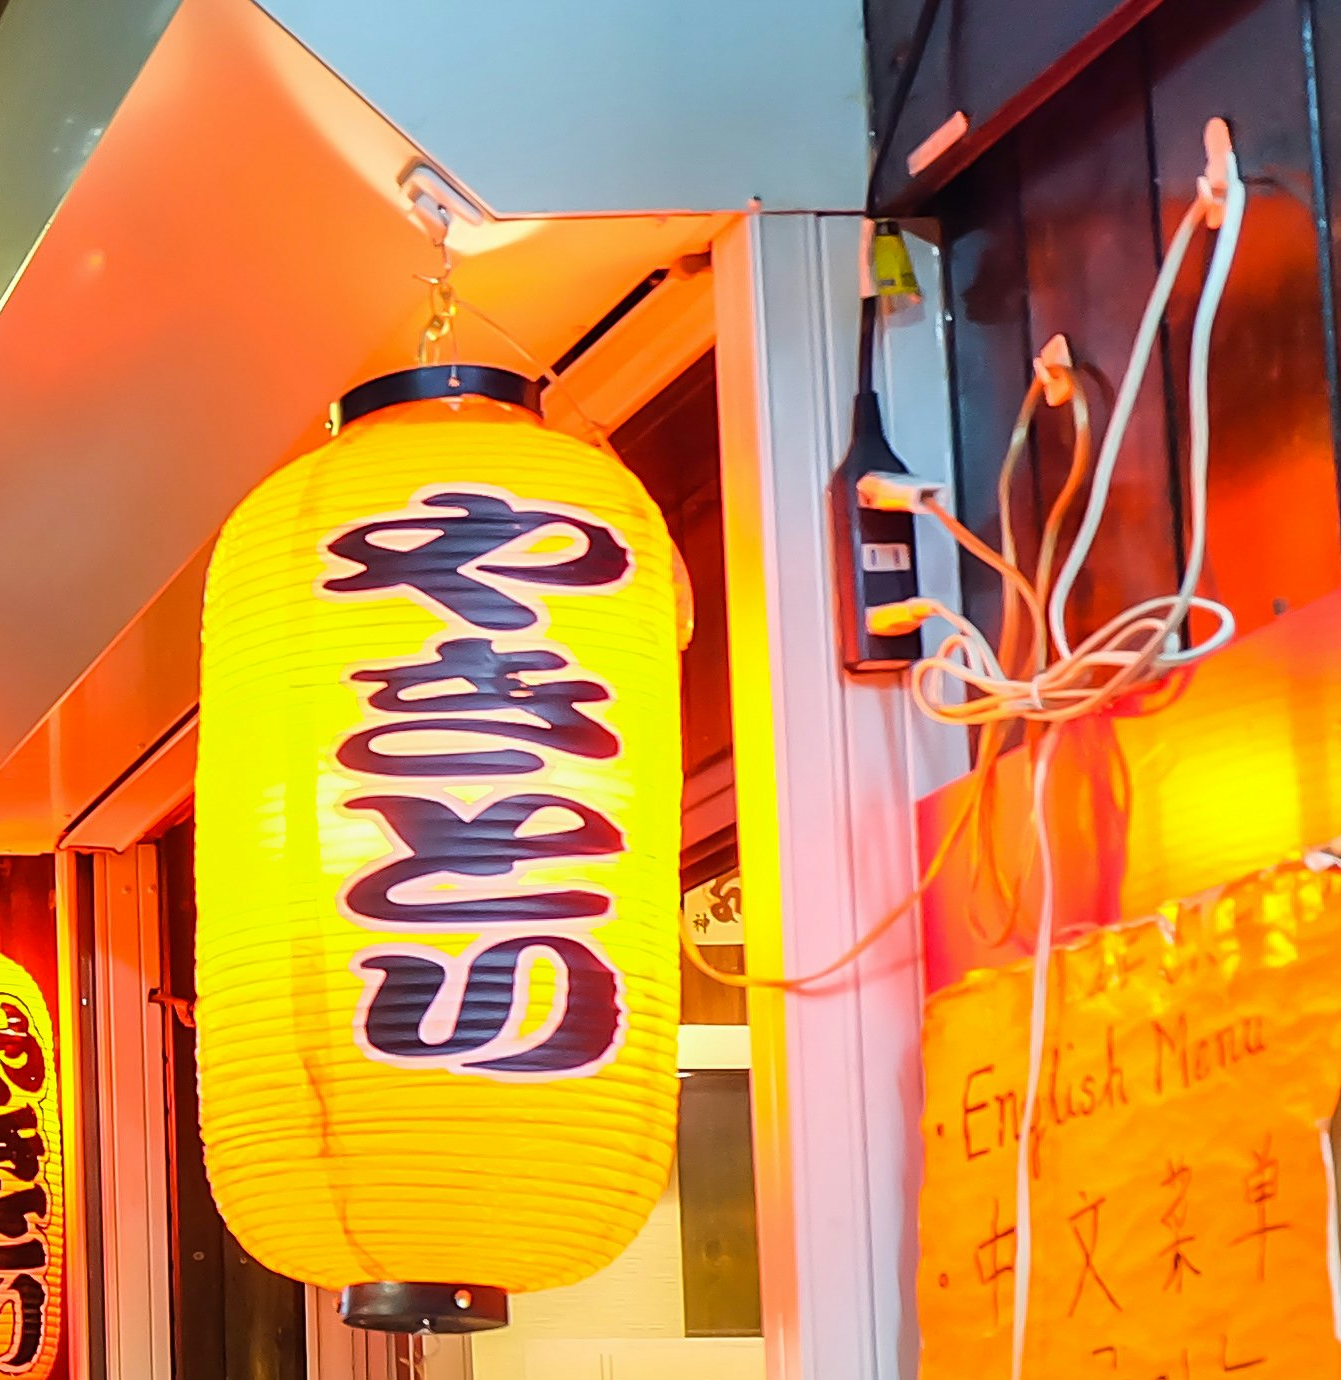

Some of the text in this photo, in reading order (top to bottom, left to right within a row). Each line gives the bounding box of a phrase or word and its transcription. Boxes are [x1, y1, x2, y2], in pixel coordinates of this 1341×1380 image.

[321, 491, 632, 1073] やきとり
[1150, 1012, 1267, 1096] Menu
